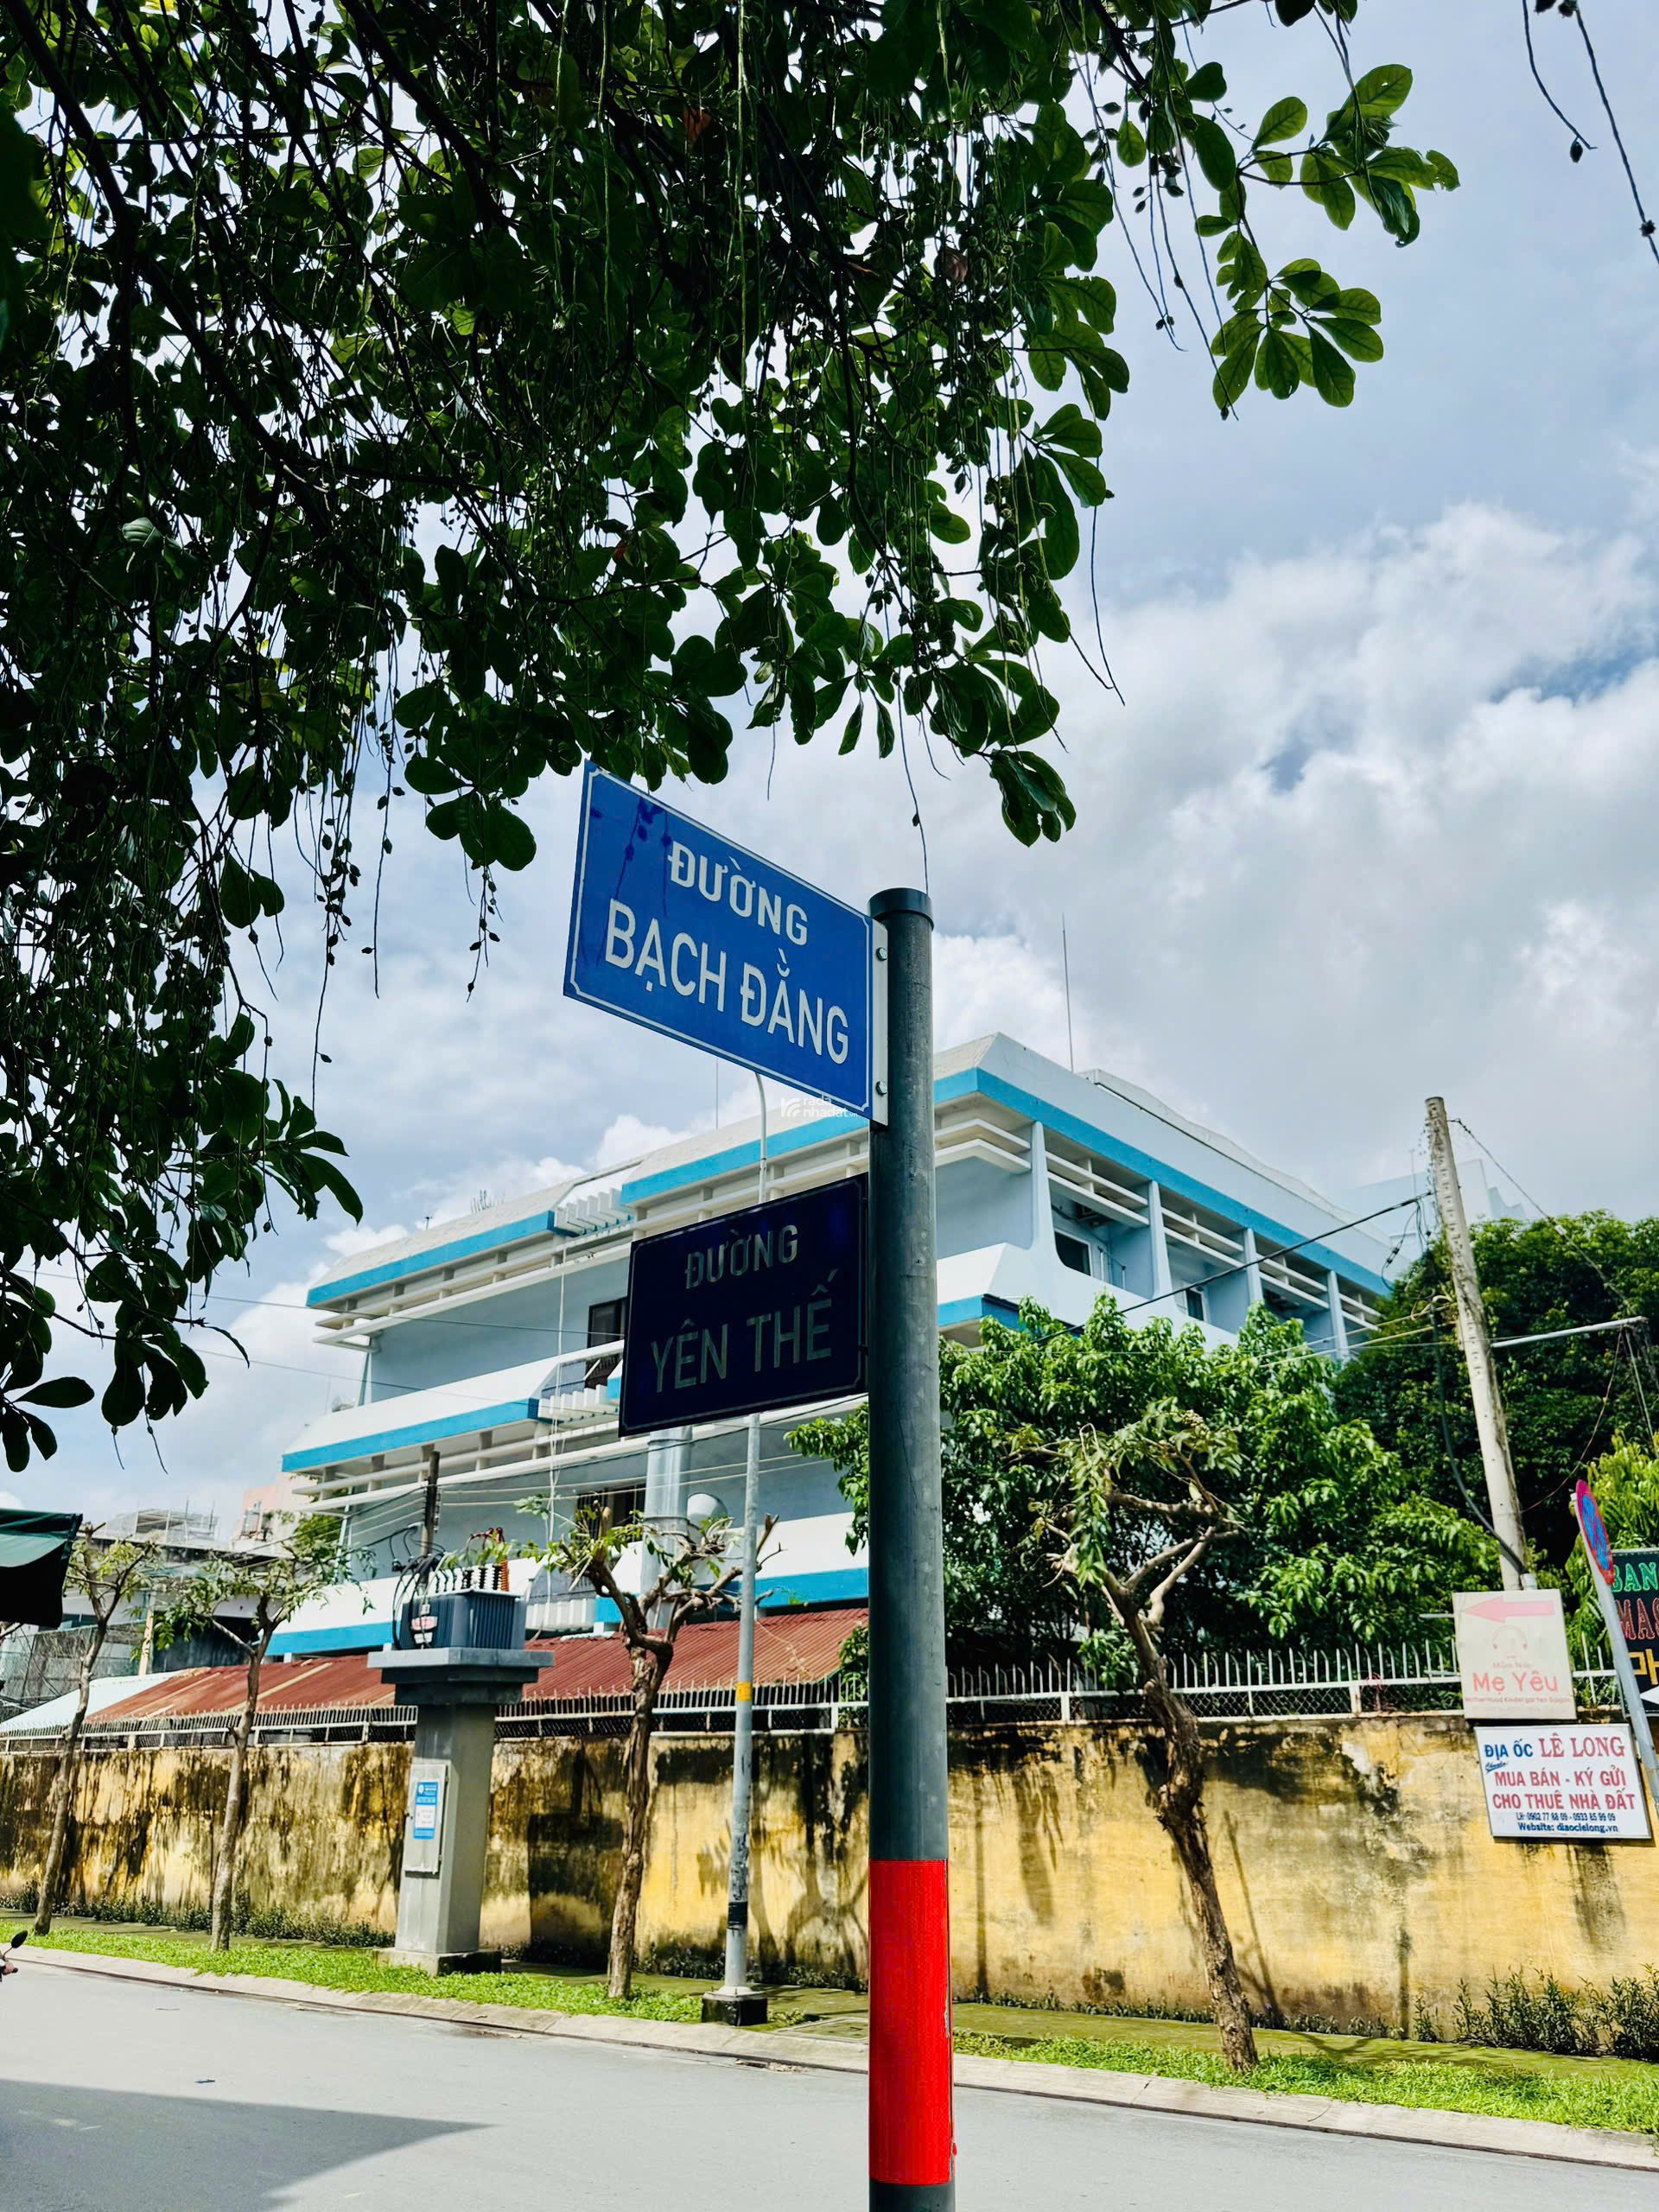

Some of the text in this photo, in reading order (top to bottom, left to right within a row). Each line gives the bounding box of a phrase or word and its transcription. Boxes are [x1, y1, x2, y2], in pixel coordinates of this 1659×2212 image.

[668, 841, 808, 946] ĐƯỜNG
[605, 898, 849, 1065] BẠCH ĐẰNG
[684, 1224, 798, 1289] ĐƯỜNG
[651, 1268, 838, 1393] YÊN THẾ
[1611, 1561, 1659, 1592] BAN
[1472, 1670, 1559, 1695] Mẹ Yêu
[1484, 1732, 1624, 1760] ĐỊA ỐC LÊ LONG
[1495, 1771, 1526, 1786] MUA
[1529, 1767, 1560, 1786] BÁN
[1574, 1767, 1593, 1786] KÝ
[1600, 1764, 1626, 1786] GỬI
[1493, 1788, 1635, 1810] CHO THUÊ NHÀ ĐẤT
[1518, 1822, 1554, 1832] Website:
